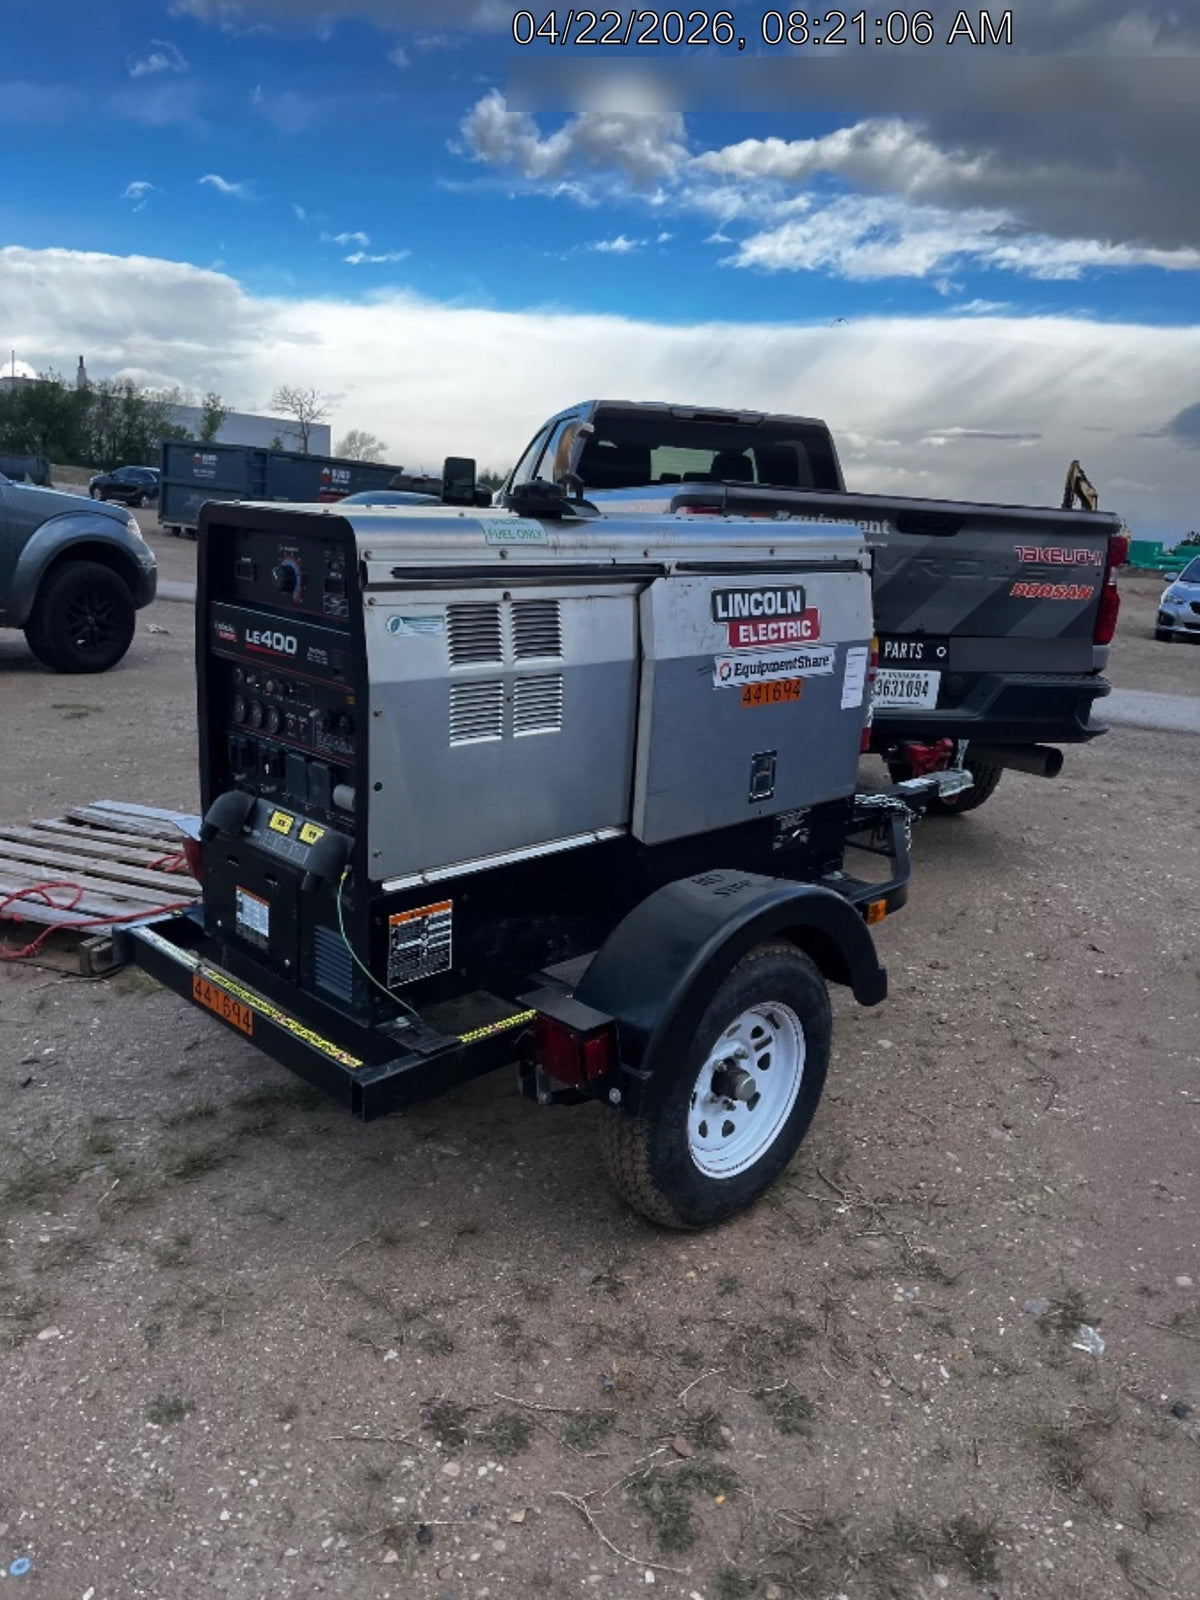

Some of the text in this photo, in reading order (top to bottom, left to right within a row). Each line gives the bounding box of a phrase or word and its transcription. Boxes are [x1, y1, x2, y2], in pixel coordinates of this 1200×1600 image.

[1014, 545, 1102, 567] TAKEUCHI
[1010, 582, 1094, 600] DOOSAN
[715, 589, 802, 619] LINCOLN
[245, 627, 298, 656] LE400
[738, 620, 813, 644] ELECTRIC
[883, 641, 924, 659] PARTS
[733, 655, 831, 679] EquipmentShare
[741, 680, 802, 705] 441694
[194, 979, 253, 1031] 441694
